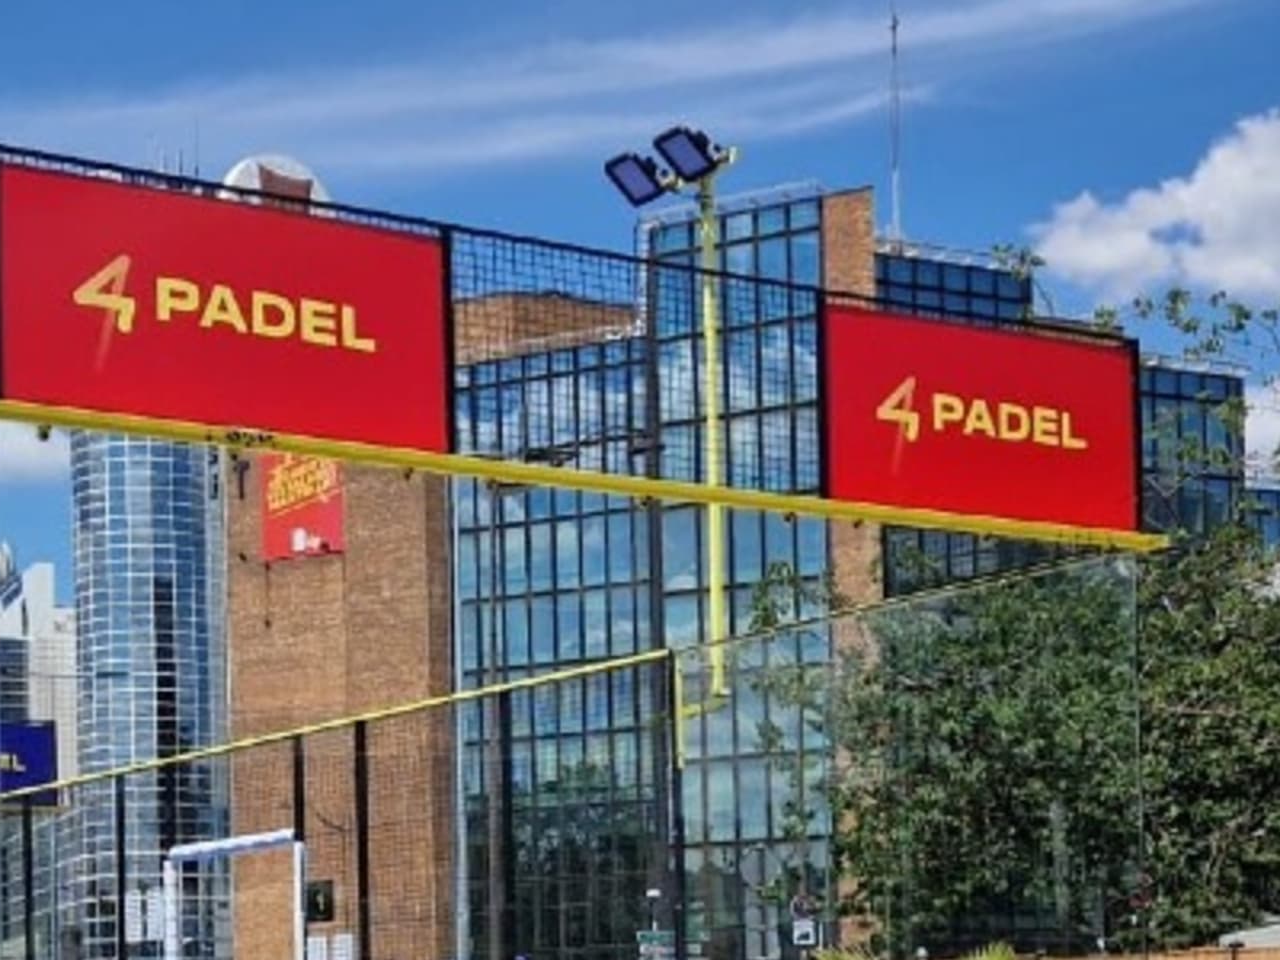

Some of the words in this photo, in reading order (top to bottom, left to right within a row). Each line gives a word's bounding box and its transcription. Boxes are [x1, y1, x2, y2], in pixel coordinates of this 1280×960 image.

[73, 254, 136, 372] 4
[156, 277, 376, 352] PADEL
[876, 376, 920, 472] 4
[932, 393, 1087, 449] PADEL
